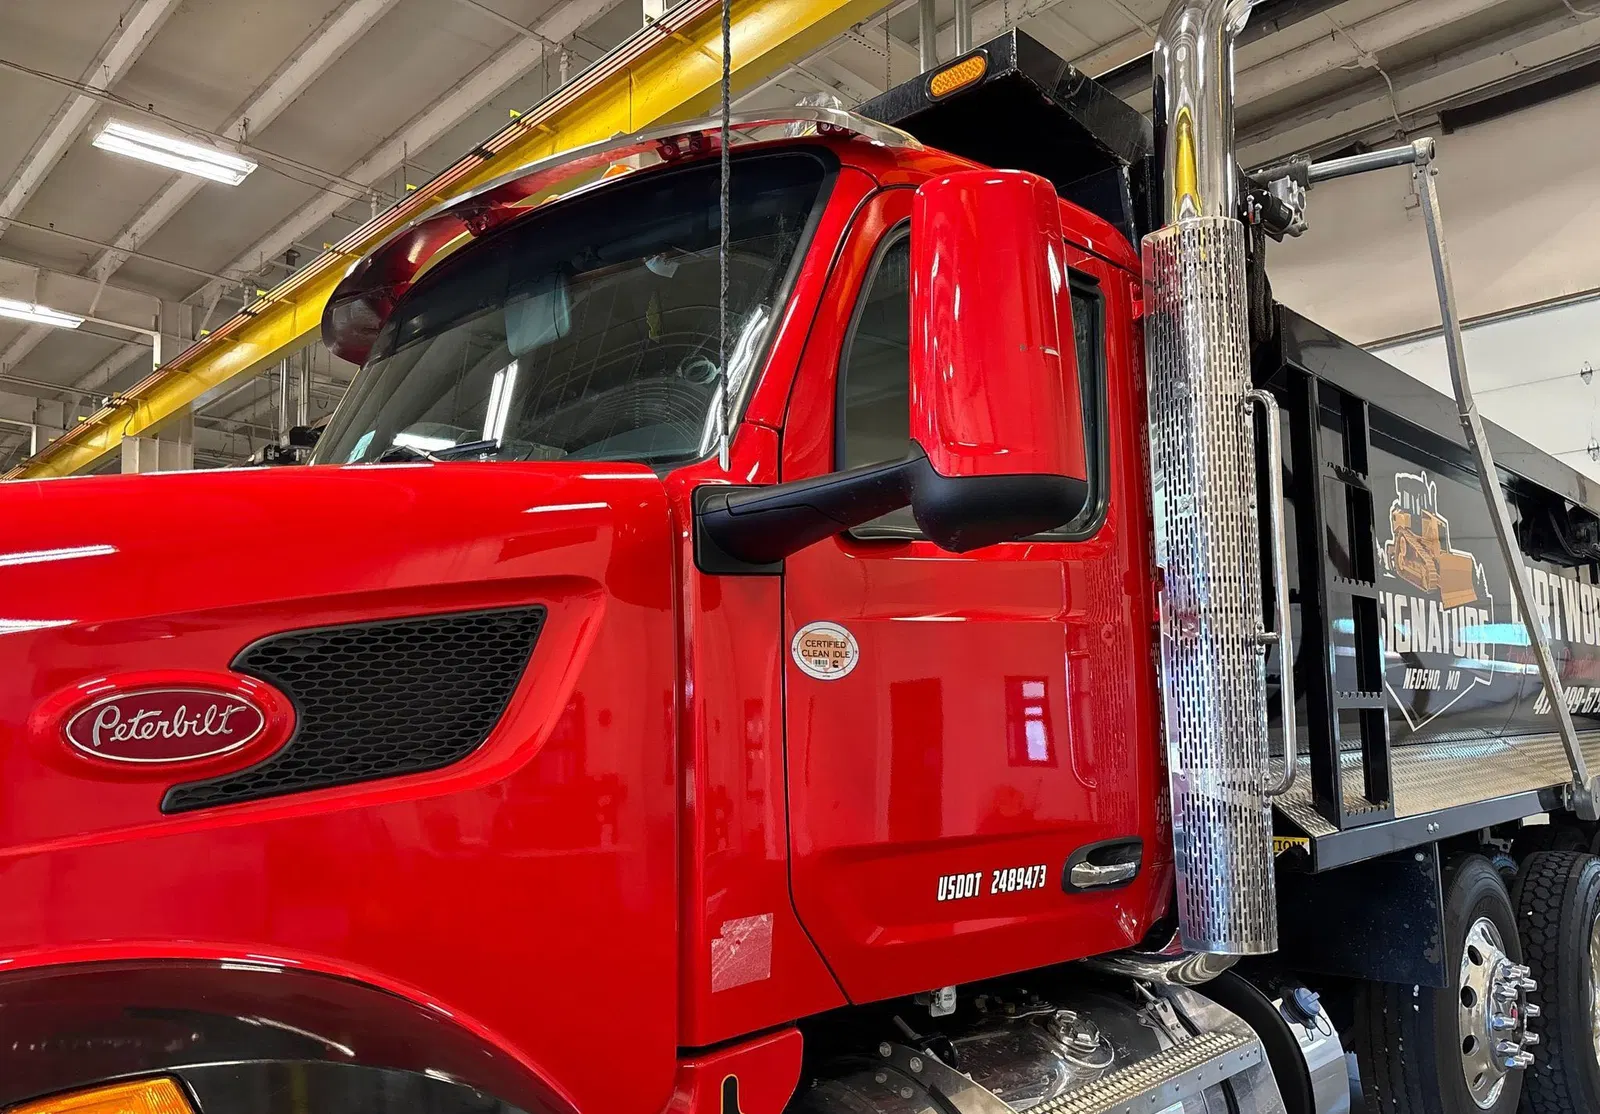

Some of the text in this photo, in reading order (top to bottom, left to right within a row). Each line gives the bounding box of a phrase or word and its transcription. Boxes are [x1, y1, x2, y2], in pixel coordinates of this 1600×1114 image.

[801, 649, 851, 659] CLEAN IDLE
[805, 640, 847, 649] CERTIFIED
[1403, 667, 1461, 692] NEOSHO, MO
[91, 704, 247, 747] Peterbilt
[936, 864, 1047, 902] USDOT 2489473
